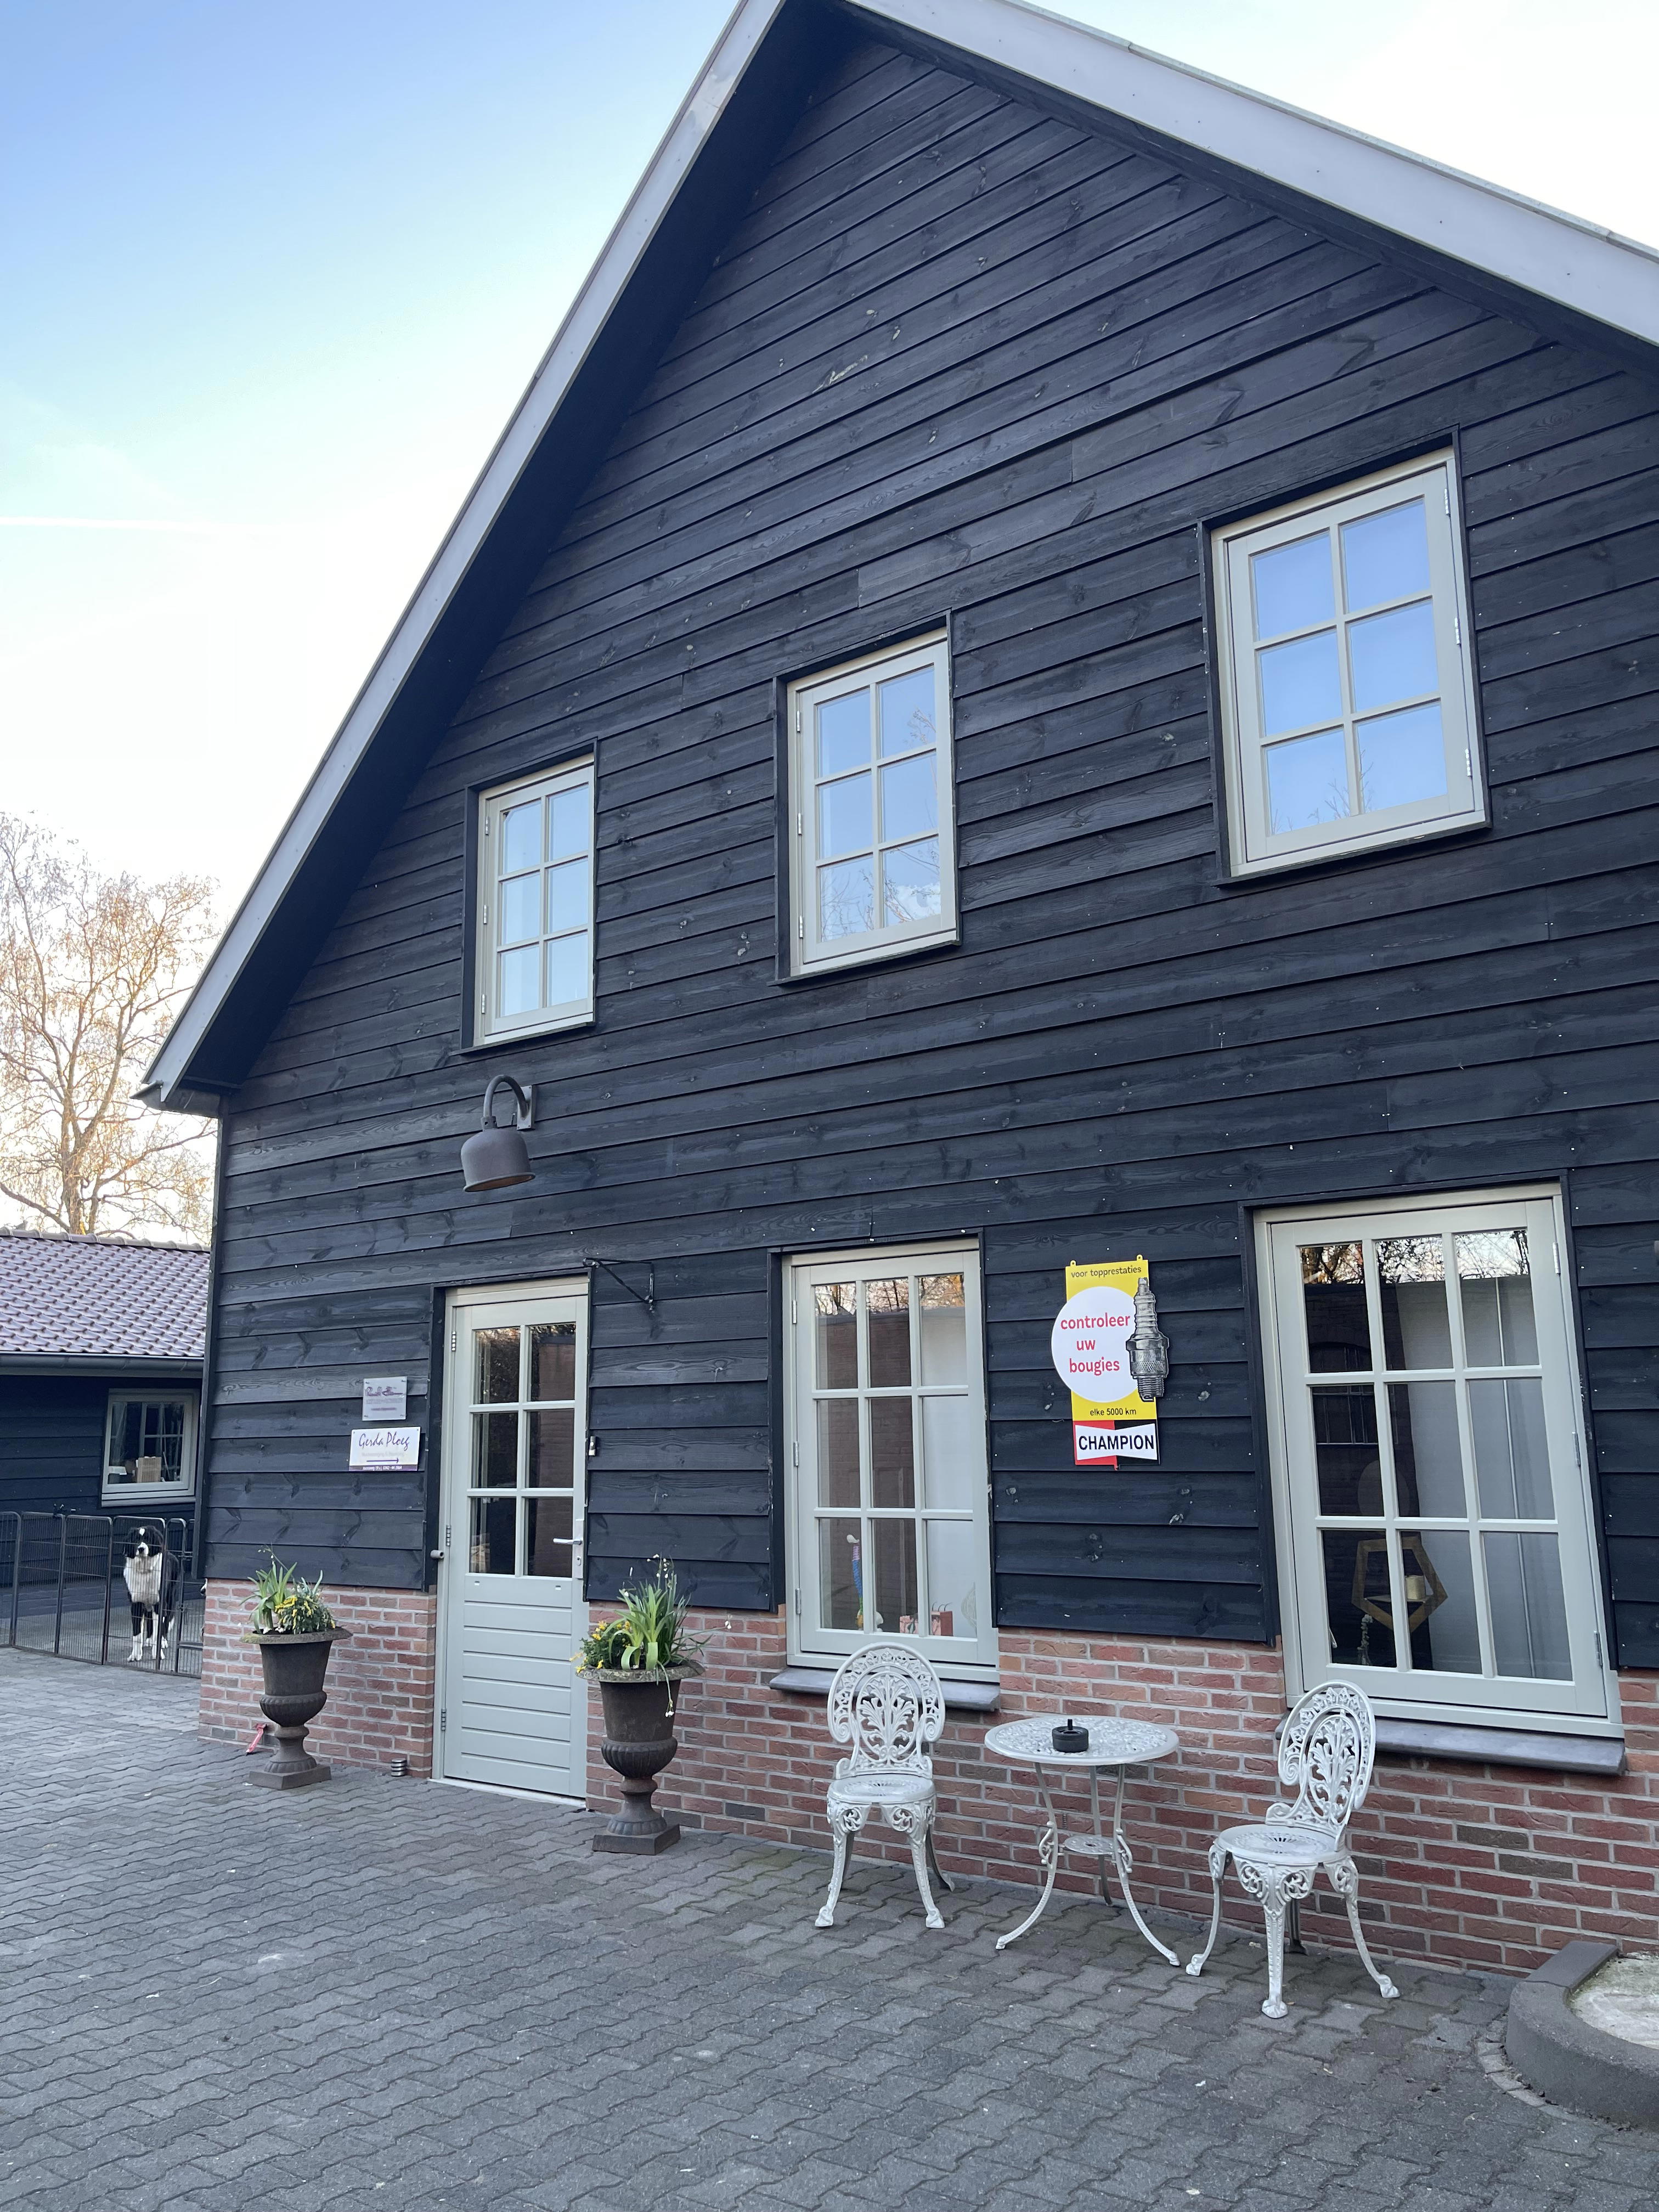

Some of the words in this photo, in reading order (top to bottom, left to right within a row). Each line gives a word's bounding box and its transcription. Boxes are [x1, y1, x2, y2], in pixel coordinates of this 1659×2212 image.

[1090, 1265, 1142, 1278] topprestaties
[1060, 1312, 1131, 1329] controleer
[1076, 1340, 1096, 1351] uw
[1069, 1356, 1120, 1376] bougies
[359, 1432, 383, 1449] Gerda
[386, 1431, 410, 1452] Ploeg
[1079, 1435, 1154, 1450] CHAMPION
